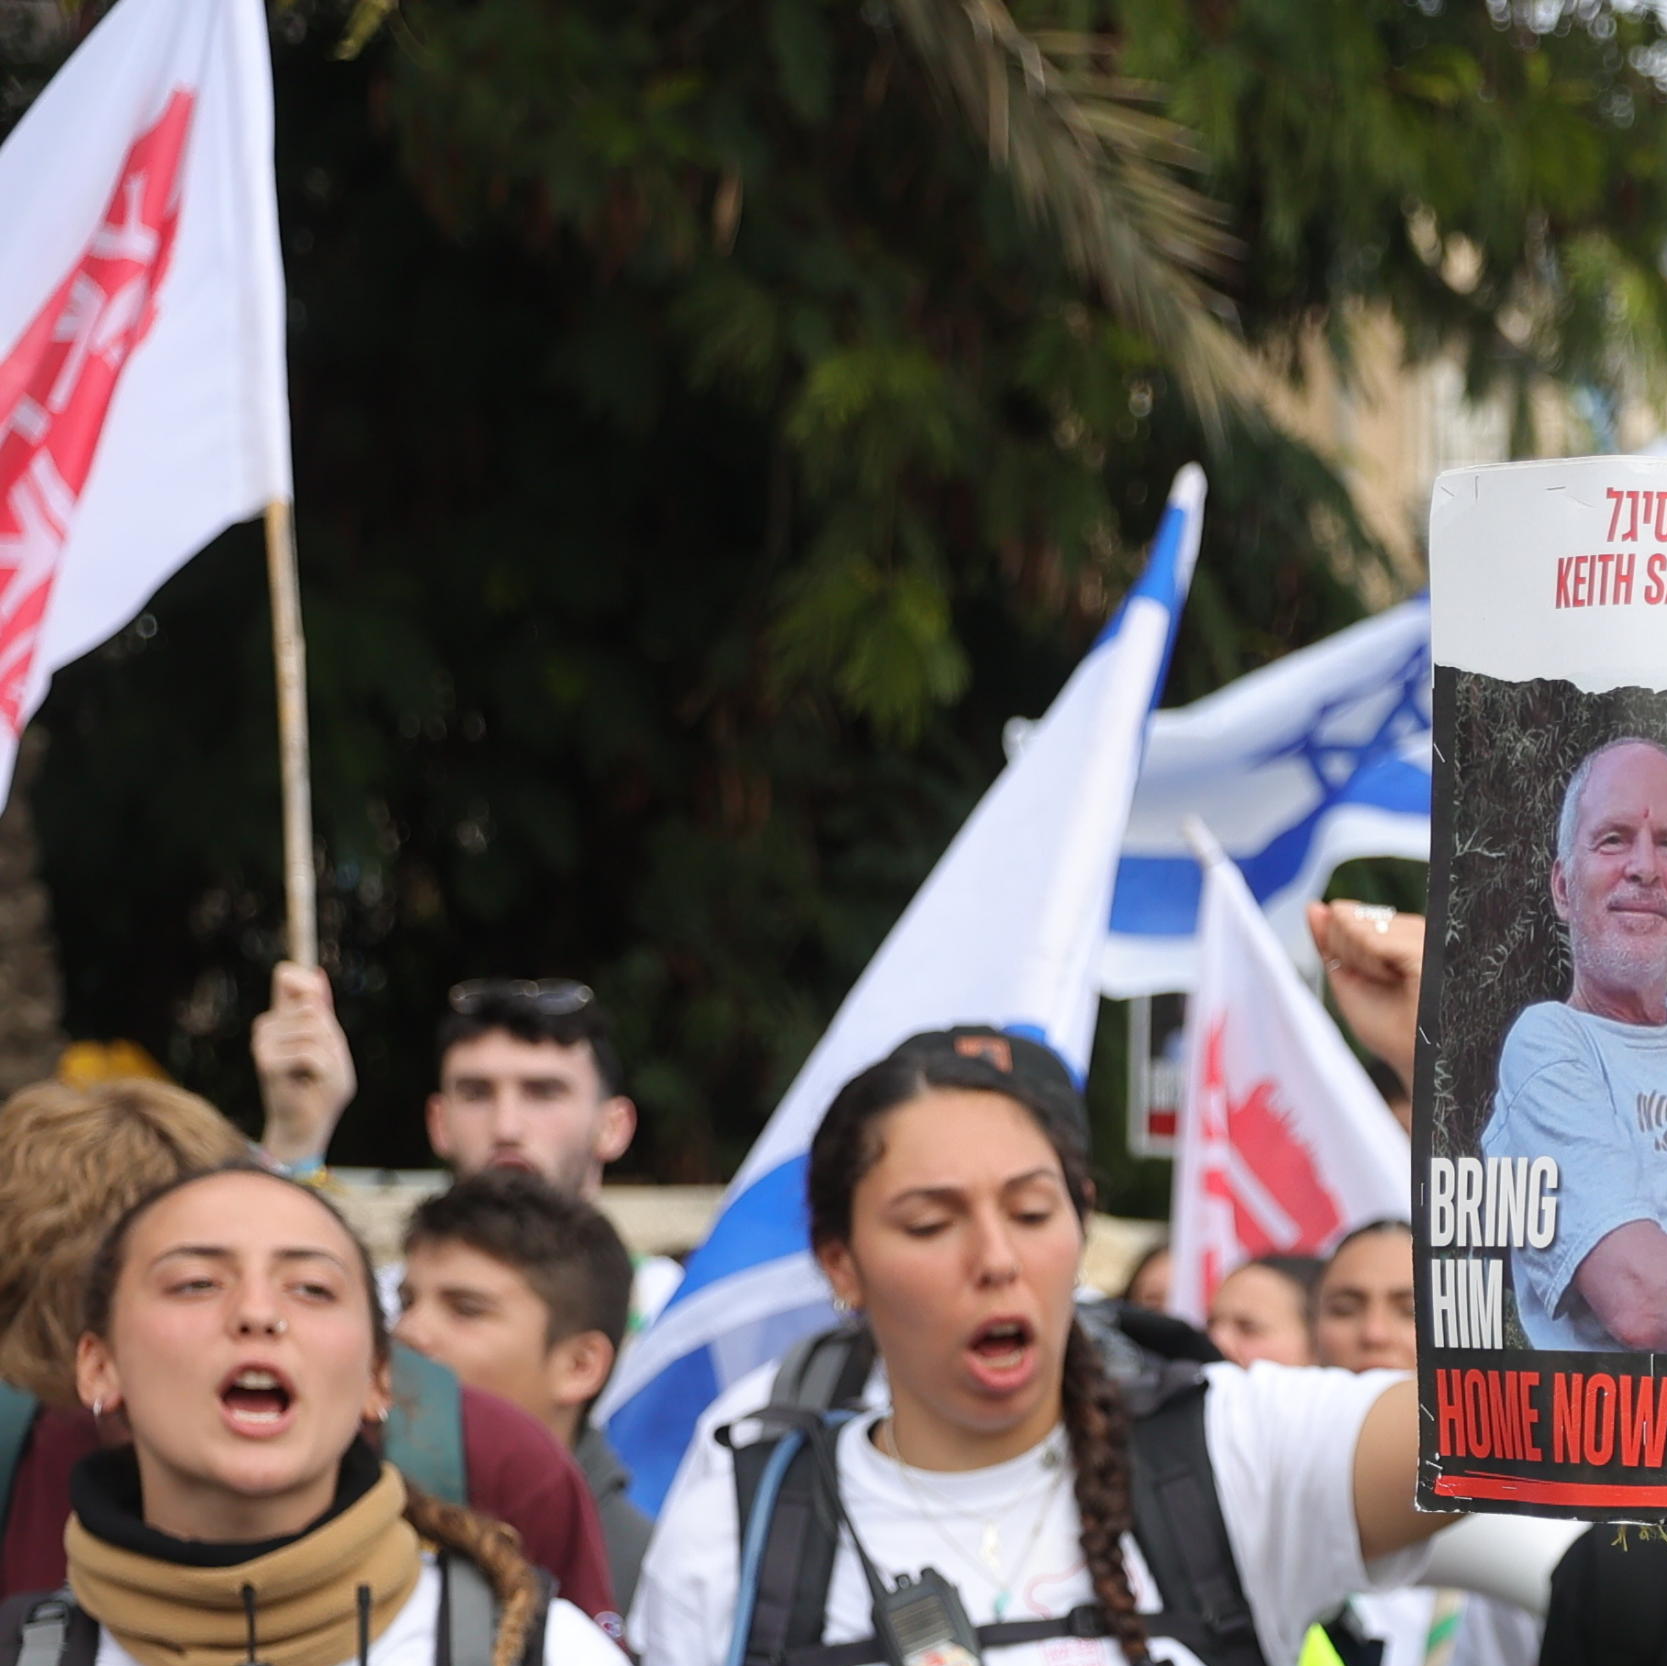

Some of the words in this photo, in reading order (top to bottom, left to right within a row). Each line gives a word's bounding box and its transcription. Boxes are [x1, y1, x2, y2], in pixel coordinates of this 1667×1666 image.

[1555, 555, 1636, 609] KEITH
[1430, 1156, 1559, 1249] BRING
[1431, 1258, 1504, 1350] HIM
[1436, 1368, 1543, 1462] HOME
